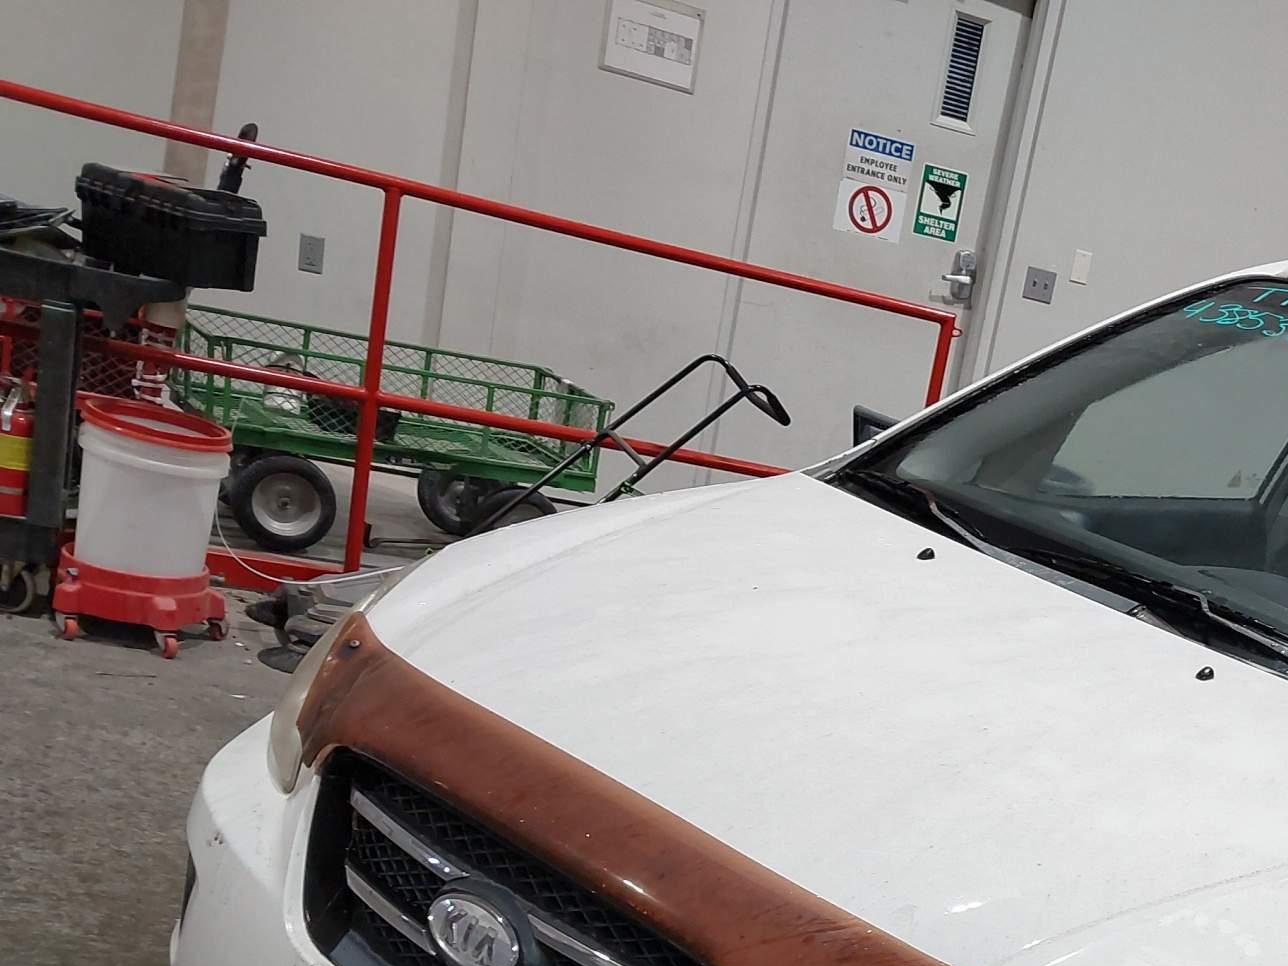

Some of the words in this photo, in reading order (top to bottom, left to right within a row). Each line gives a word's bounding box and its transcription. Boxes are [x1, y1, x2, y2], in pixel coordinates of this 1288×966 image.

[851, 131, 912, 160] NOTICE
[860, 156, 897, 172] EMPLOYEE
[846, 164, 885, 180] ENTRANCE
[887, 174, 907, 185] ONLY
[918, 215, 955, 231] SHELTER
[923, 226, 946, 238] AREA
